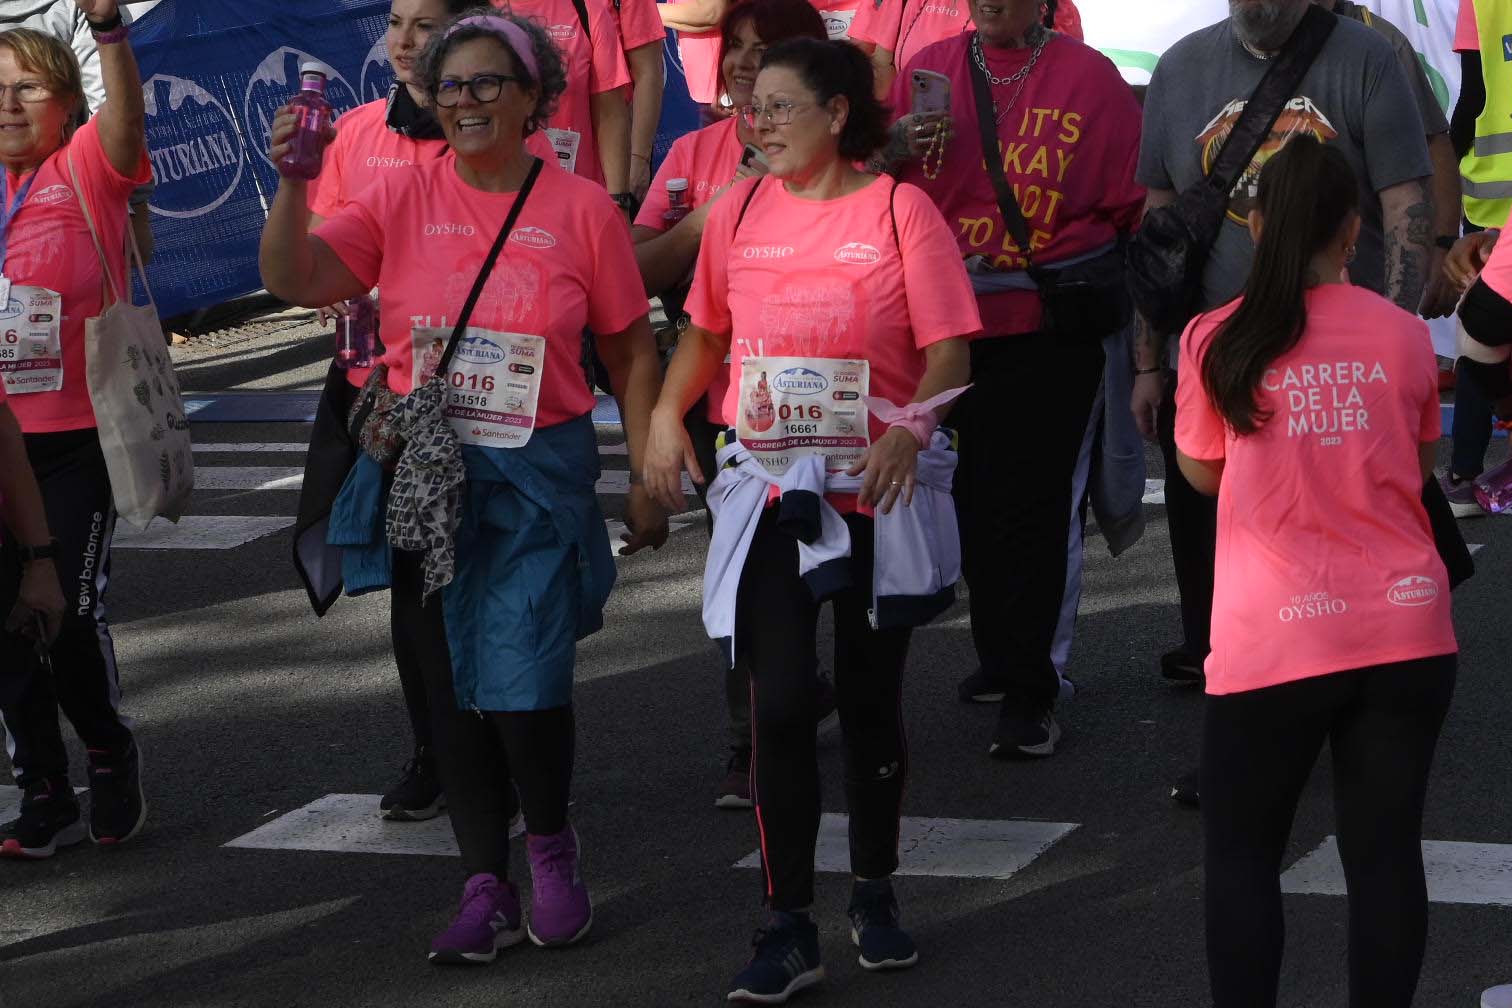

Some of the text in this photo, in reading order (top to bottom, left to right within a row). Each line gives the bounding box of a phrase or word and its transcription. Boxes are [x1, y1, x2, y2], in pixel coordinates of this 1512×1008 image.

[1018, 107, 1082, 144] IT'S
[424, 223, 475, 237] OYSHO
[743, 246, 795, 259] OYSHO
[510, 348, 535, 358] SUMA
[16, 375, 56, 385] Santander
[451, 371, 496, 392] 016
[775, 376, 824, 390] ASTURIANA
[833, 375, 859, 384] SUMA
[1262, 362, 1389, 392] CARRERA
[453, 394, 488, 407] 31518
[1288, 387, 1363, 412] DE LA
[477, 411, 503, 421] MUJER
[778, 404, 823, 420] 016
[1287, 408, 1370, 437] MUJER
[481, 428, 522, 441] Santander
[785, 424, 818, 435] 16661
[751, 441, 787, 449] CARRERA
[788, 438, 798, 446] DE
[1320, 436, 1342, 446] 2023
[76, 511, 103, 616] new balance
[1279, 598, 1346, 623] OYSHO
